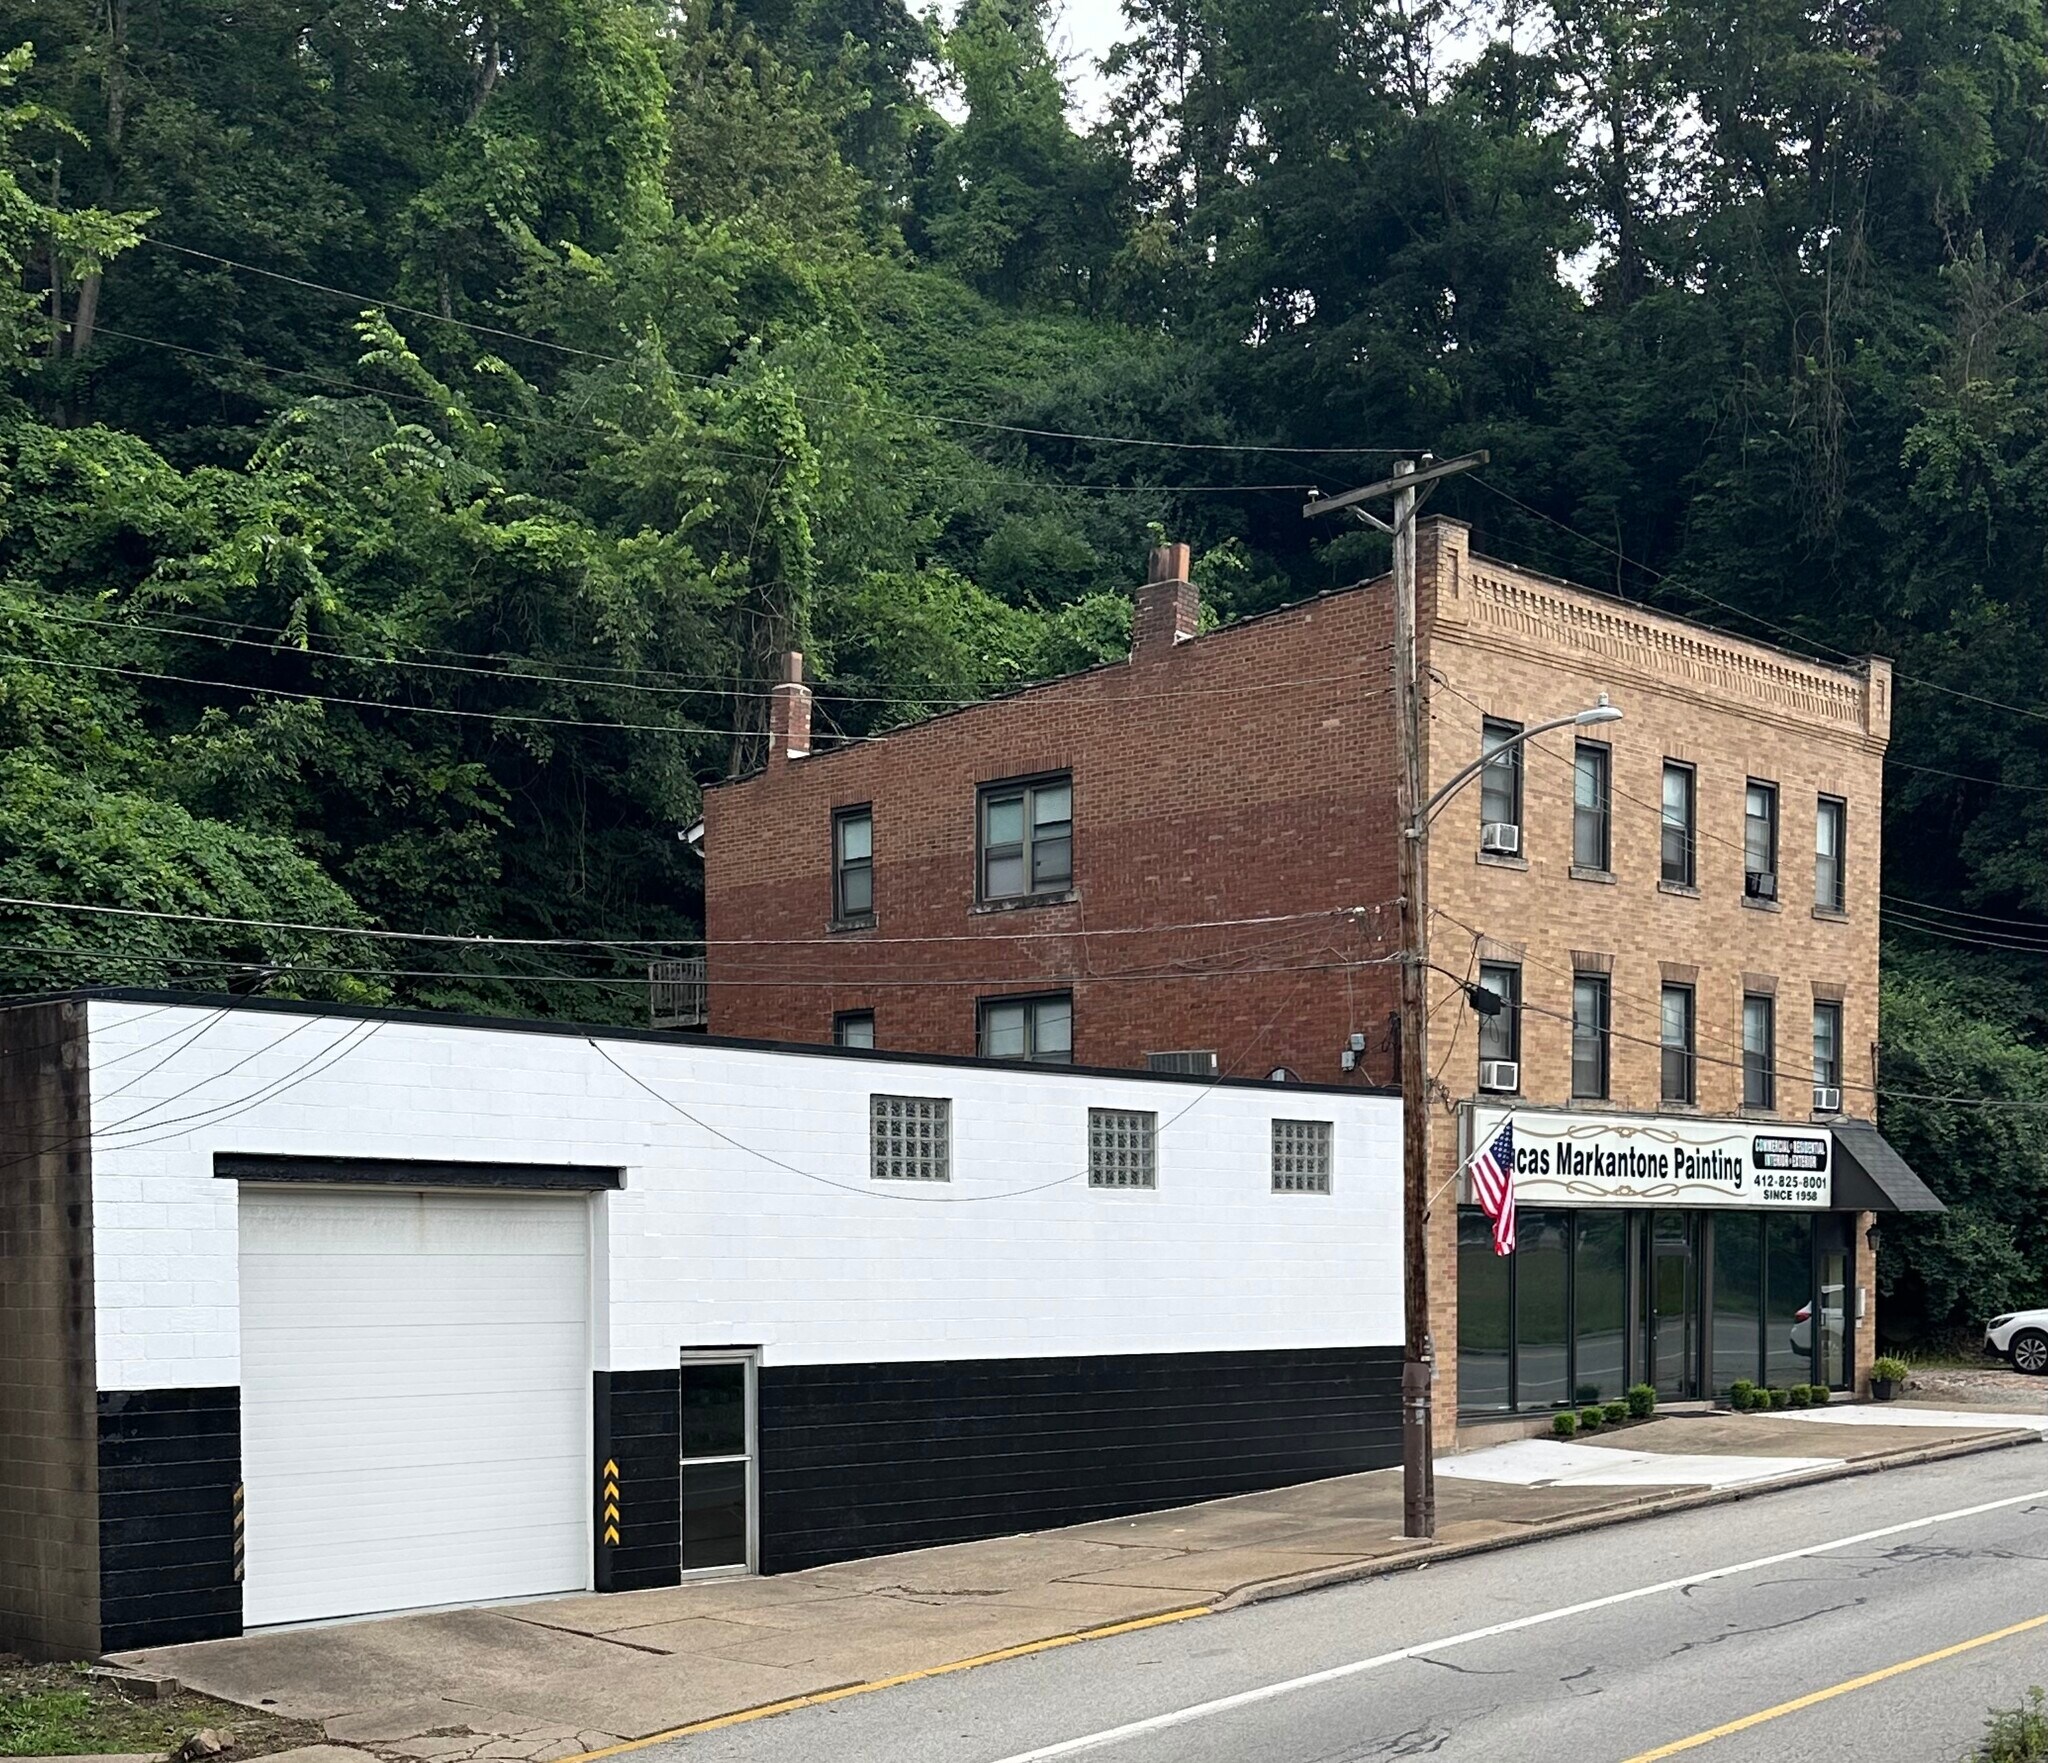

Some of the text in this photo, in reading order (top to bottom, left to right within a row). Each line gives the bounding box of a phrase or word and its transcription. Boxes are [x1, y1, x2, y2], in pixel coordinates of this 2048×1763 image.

[1512, 1141, 1742, 1189] cas Markantone Painting
[1754, 1174, 1826, 1189] 412-825-8001
[1763, 1189, 1818, 1202] SINCE 1958
